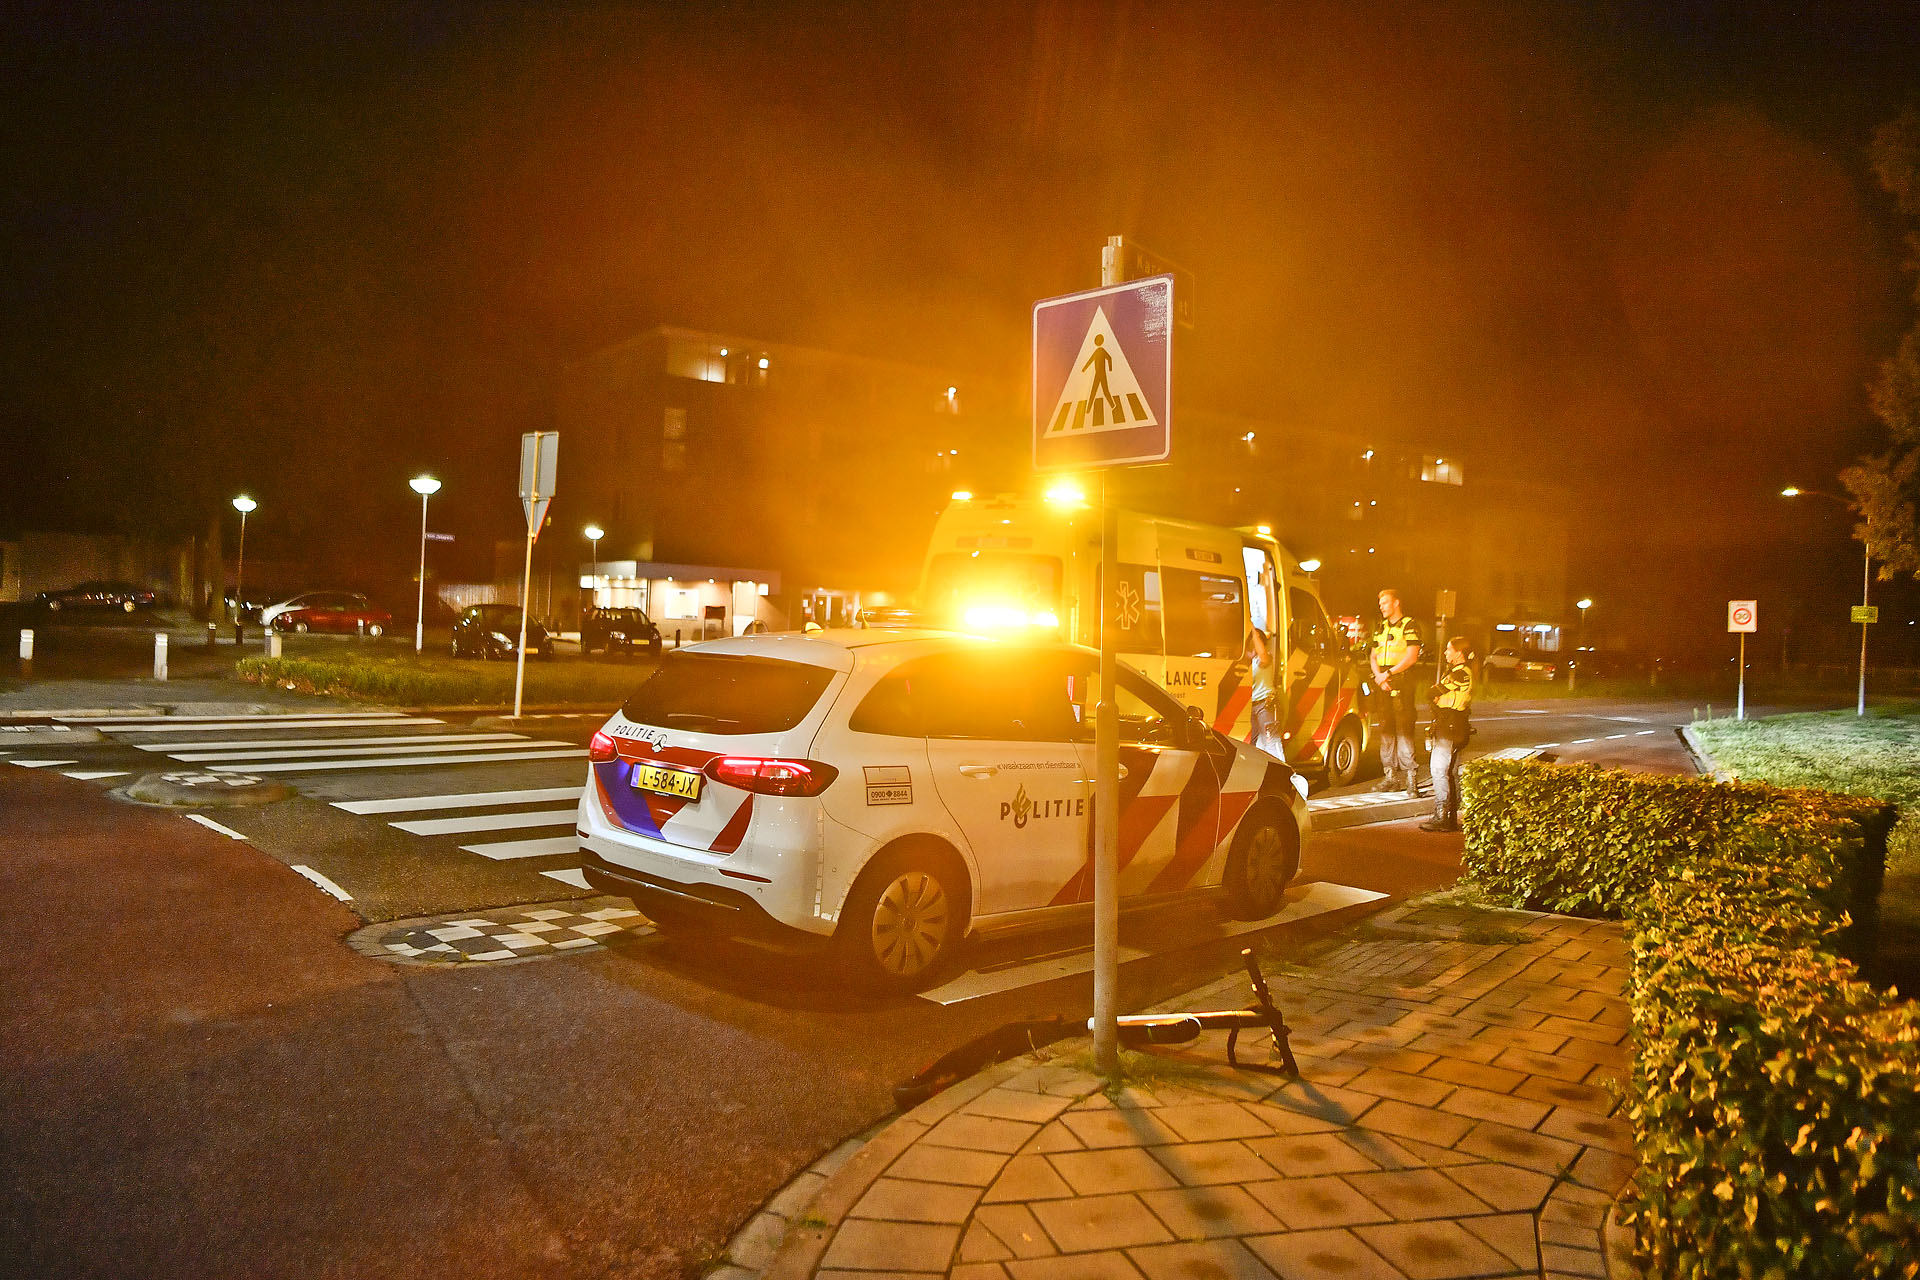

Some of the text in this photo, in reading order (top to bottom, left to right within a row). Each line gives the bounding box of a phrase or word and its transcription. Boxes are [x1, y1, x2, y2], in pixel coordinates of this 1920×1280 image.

[613, 725, 655, 740] POLITIE
[1002, 761, 1036, 769] waakzaam
[1045, 761, 1076, 769] dienstbaar
[642, 769, 696, 795] L-584-JX
[871, 790, 908, 798] 0900 8844
[1000, 798, 1084, 829] POLITIE
